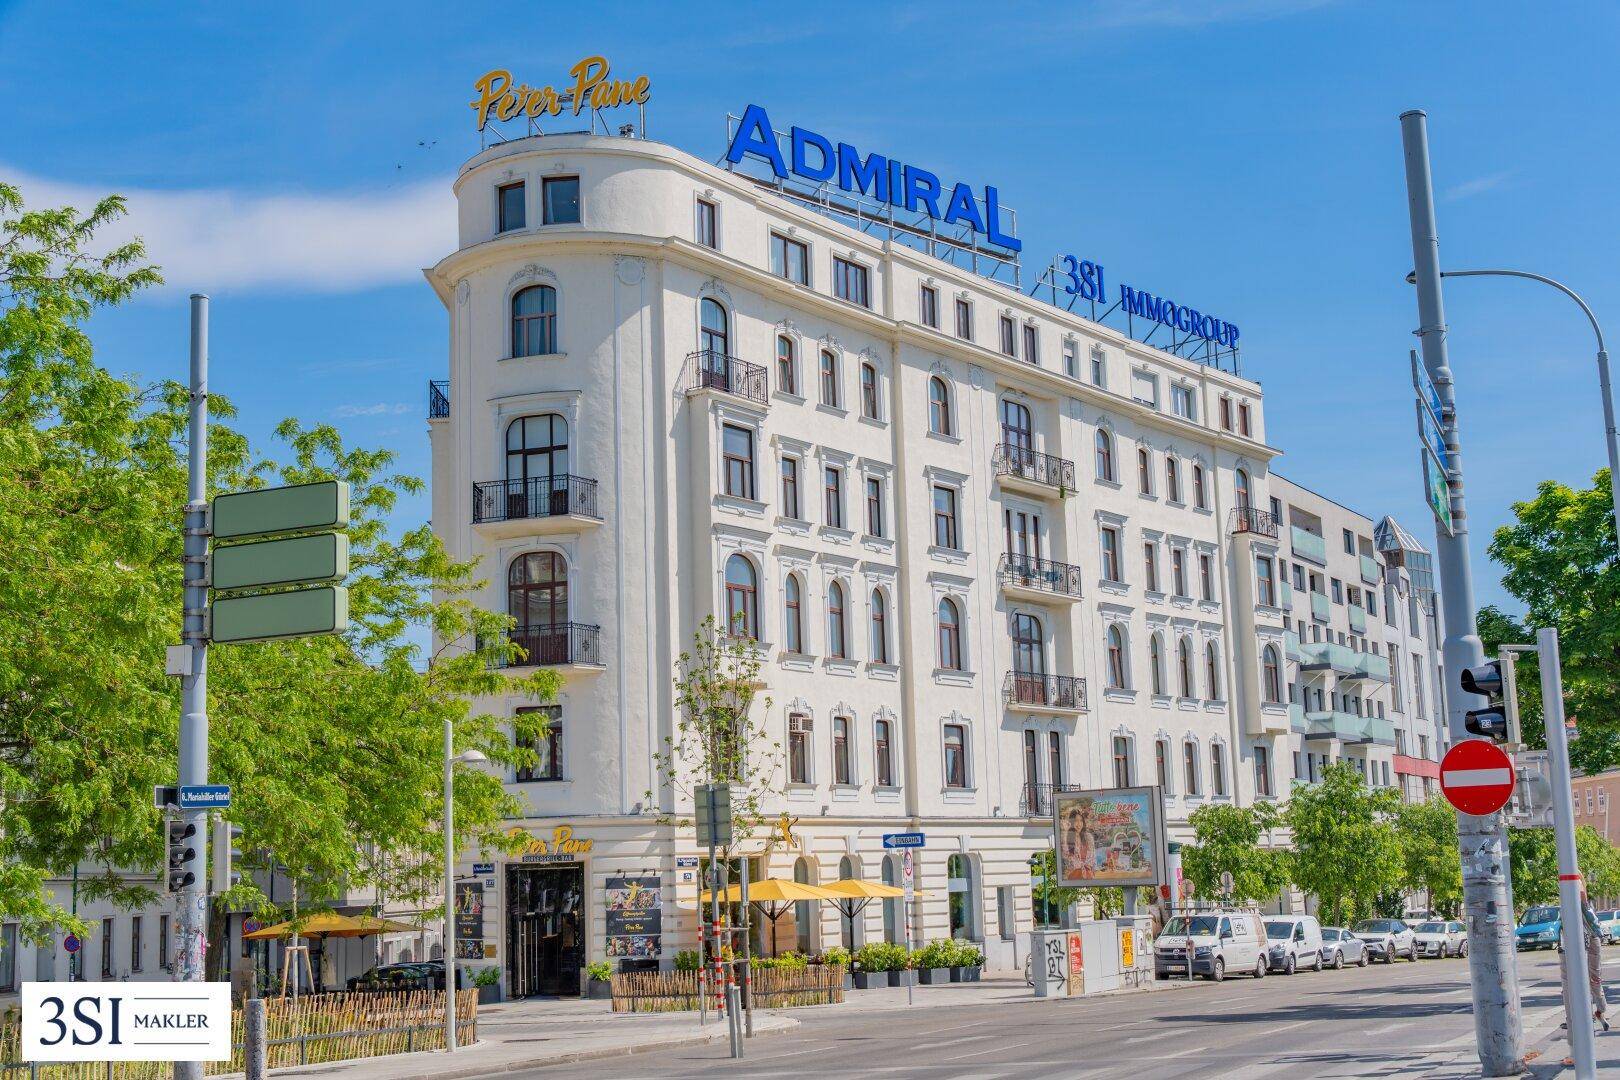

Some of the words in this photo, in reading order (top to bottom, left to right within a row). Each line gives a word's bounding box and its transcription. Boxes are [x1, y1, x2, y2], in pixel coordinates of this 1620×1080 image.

[470, 69, 562, 132] Peter
[566, 55, 651, 116] Pane
[726, 104, 1022, 252] ADMIRAL
[1063, 254, 1107, 304] 3SI
[1120, 284, 1240, 349] IMMOGROUP
[551, 826, 594, 855] Pane
